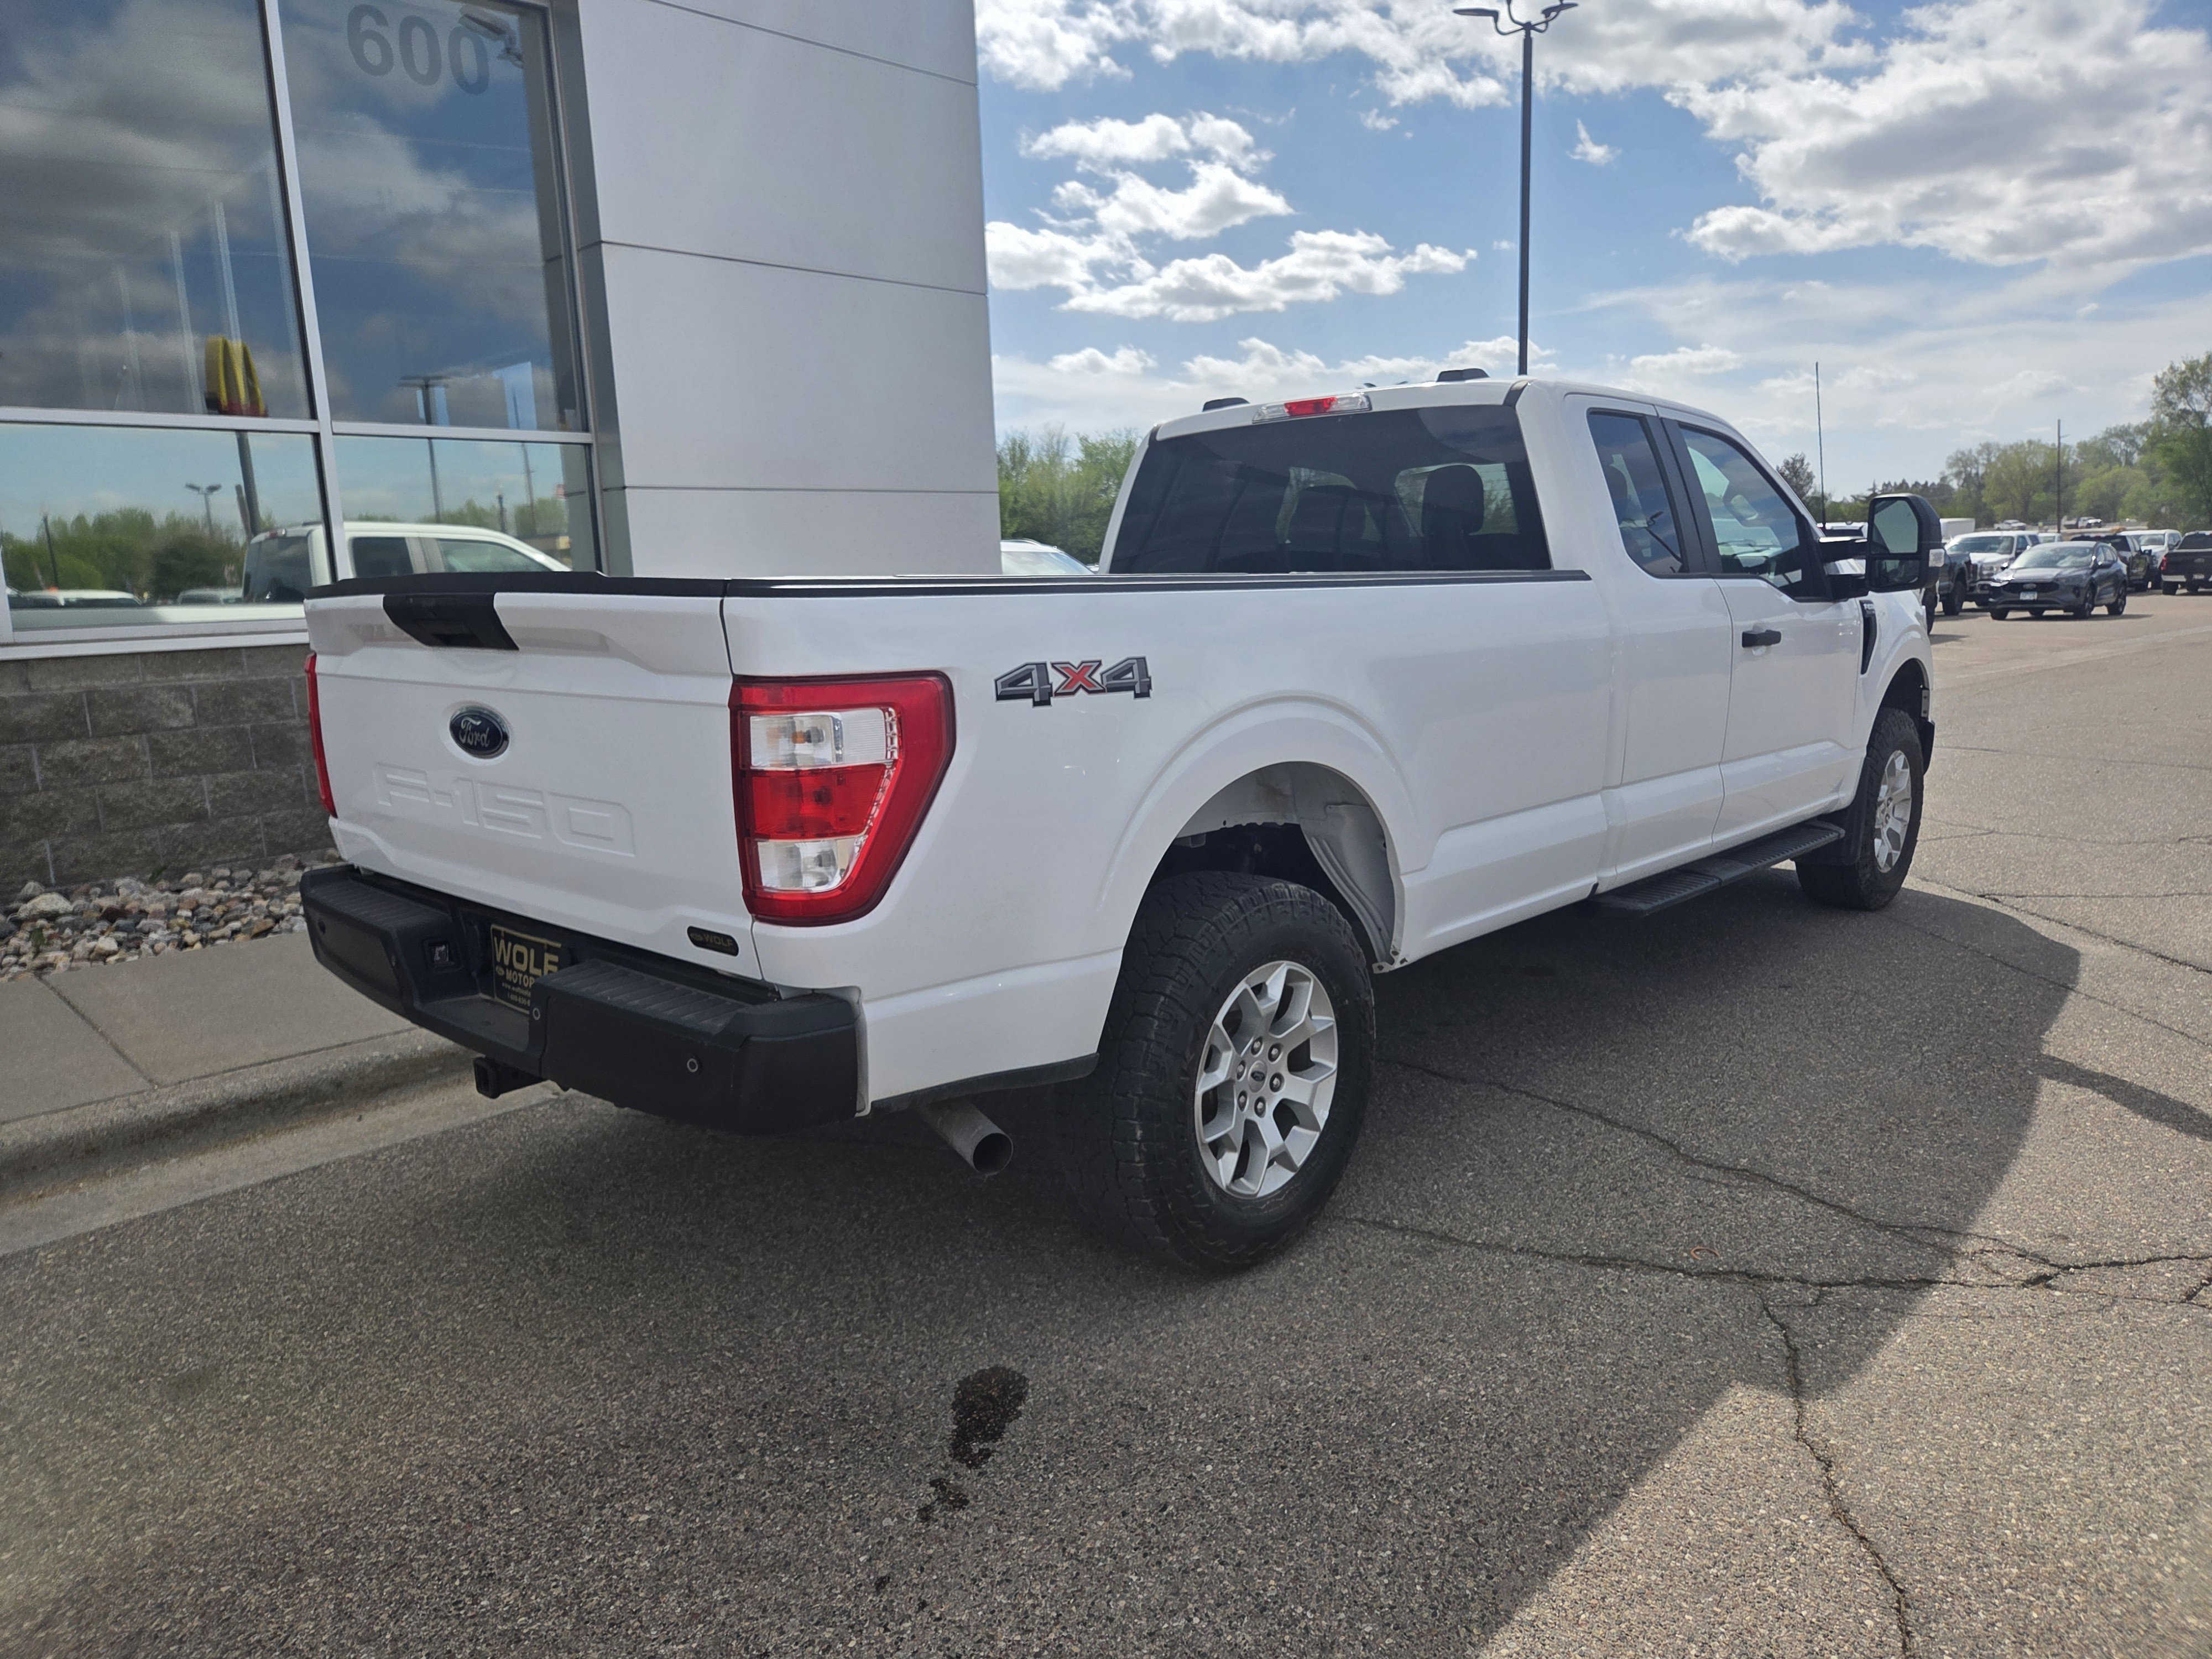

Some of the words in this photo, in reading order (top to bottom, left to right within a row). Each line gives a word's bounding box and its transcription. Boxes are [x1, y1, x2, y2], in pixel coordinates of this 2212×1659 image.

[347, 3, 490, 95] 600
[458, 716, 490, 748] Ford
[373, 761, 637, 858] F-150
[494, 937, 559, 976] WOLF
